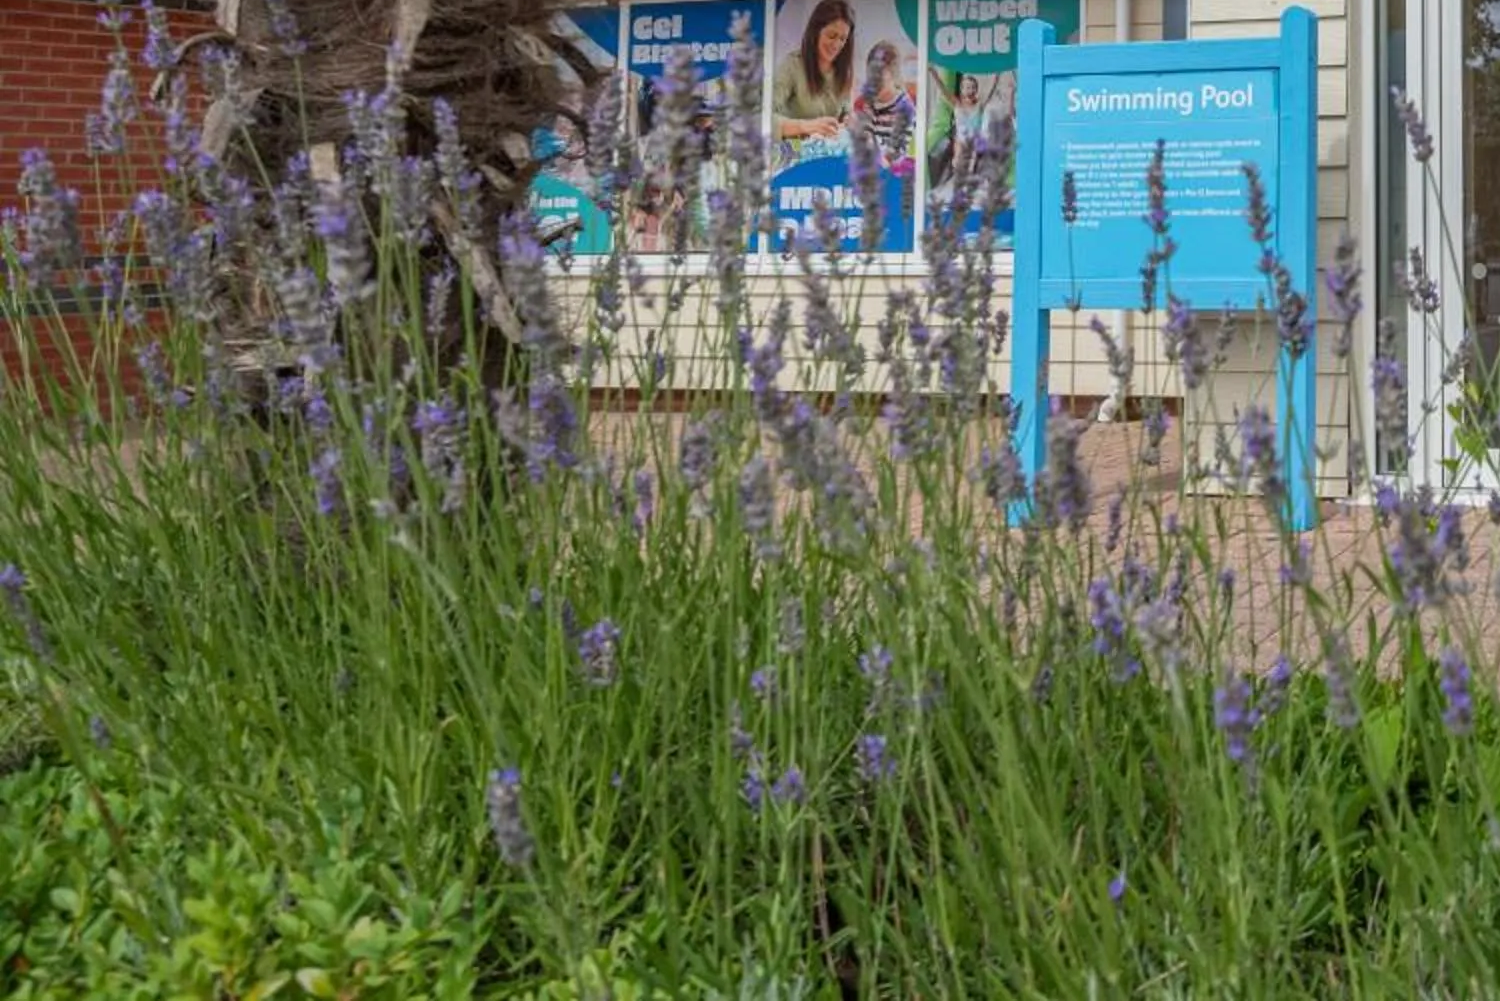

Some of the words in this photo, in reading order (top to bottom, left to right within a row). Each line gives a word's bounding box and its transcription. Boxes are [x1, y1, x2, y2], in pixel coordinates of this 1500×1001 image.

[633, 14, 683, 40] Gel
[935, 23, 1011, 56] Out
[632, 41, 745, 64] Blater
[1067, 86, 1193, 115] Swimming
[1202, 82, 1254, 107] Pool
[779, 184, 870, 210] Mak
